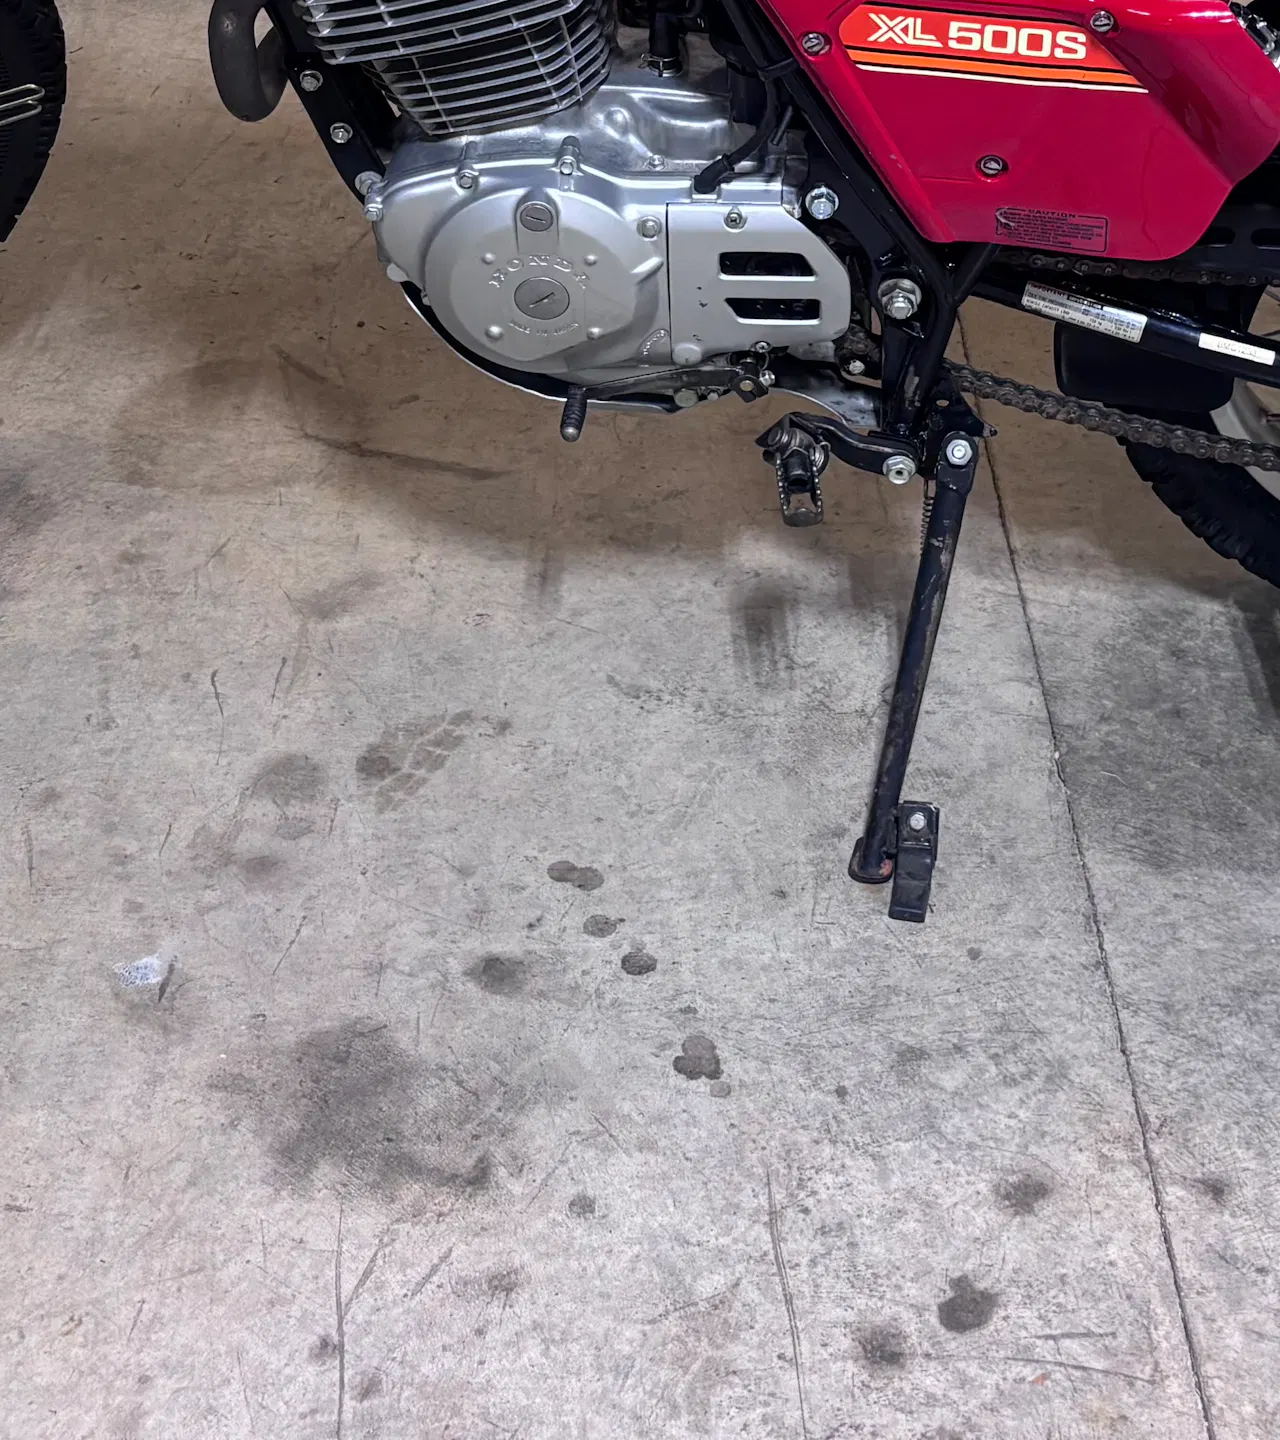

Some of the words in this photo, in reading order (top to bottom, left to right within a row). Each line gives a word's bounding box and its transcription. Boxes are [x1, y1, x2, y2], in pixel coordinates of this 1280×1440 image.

[867, 12, 944, 48] XL
[948, 21, 1088, 60] 500S
[1028, 208, 1078, 219] CAUTION
[488, 254, 590, 290] HONDA
